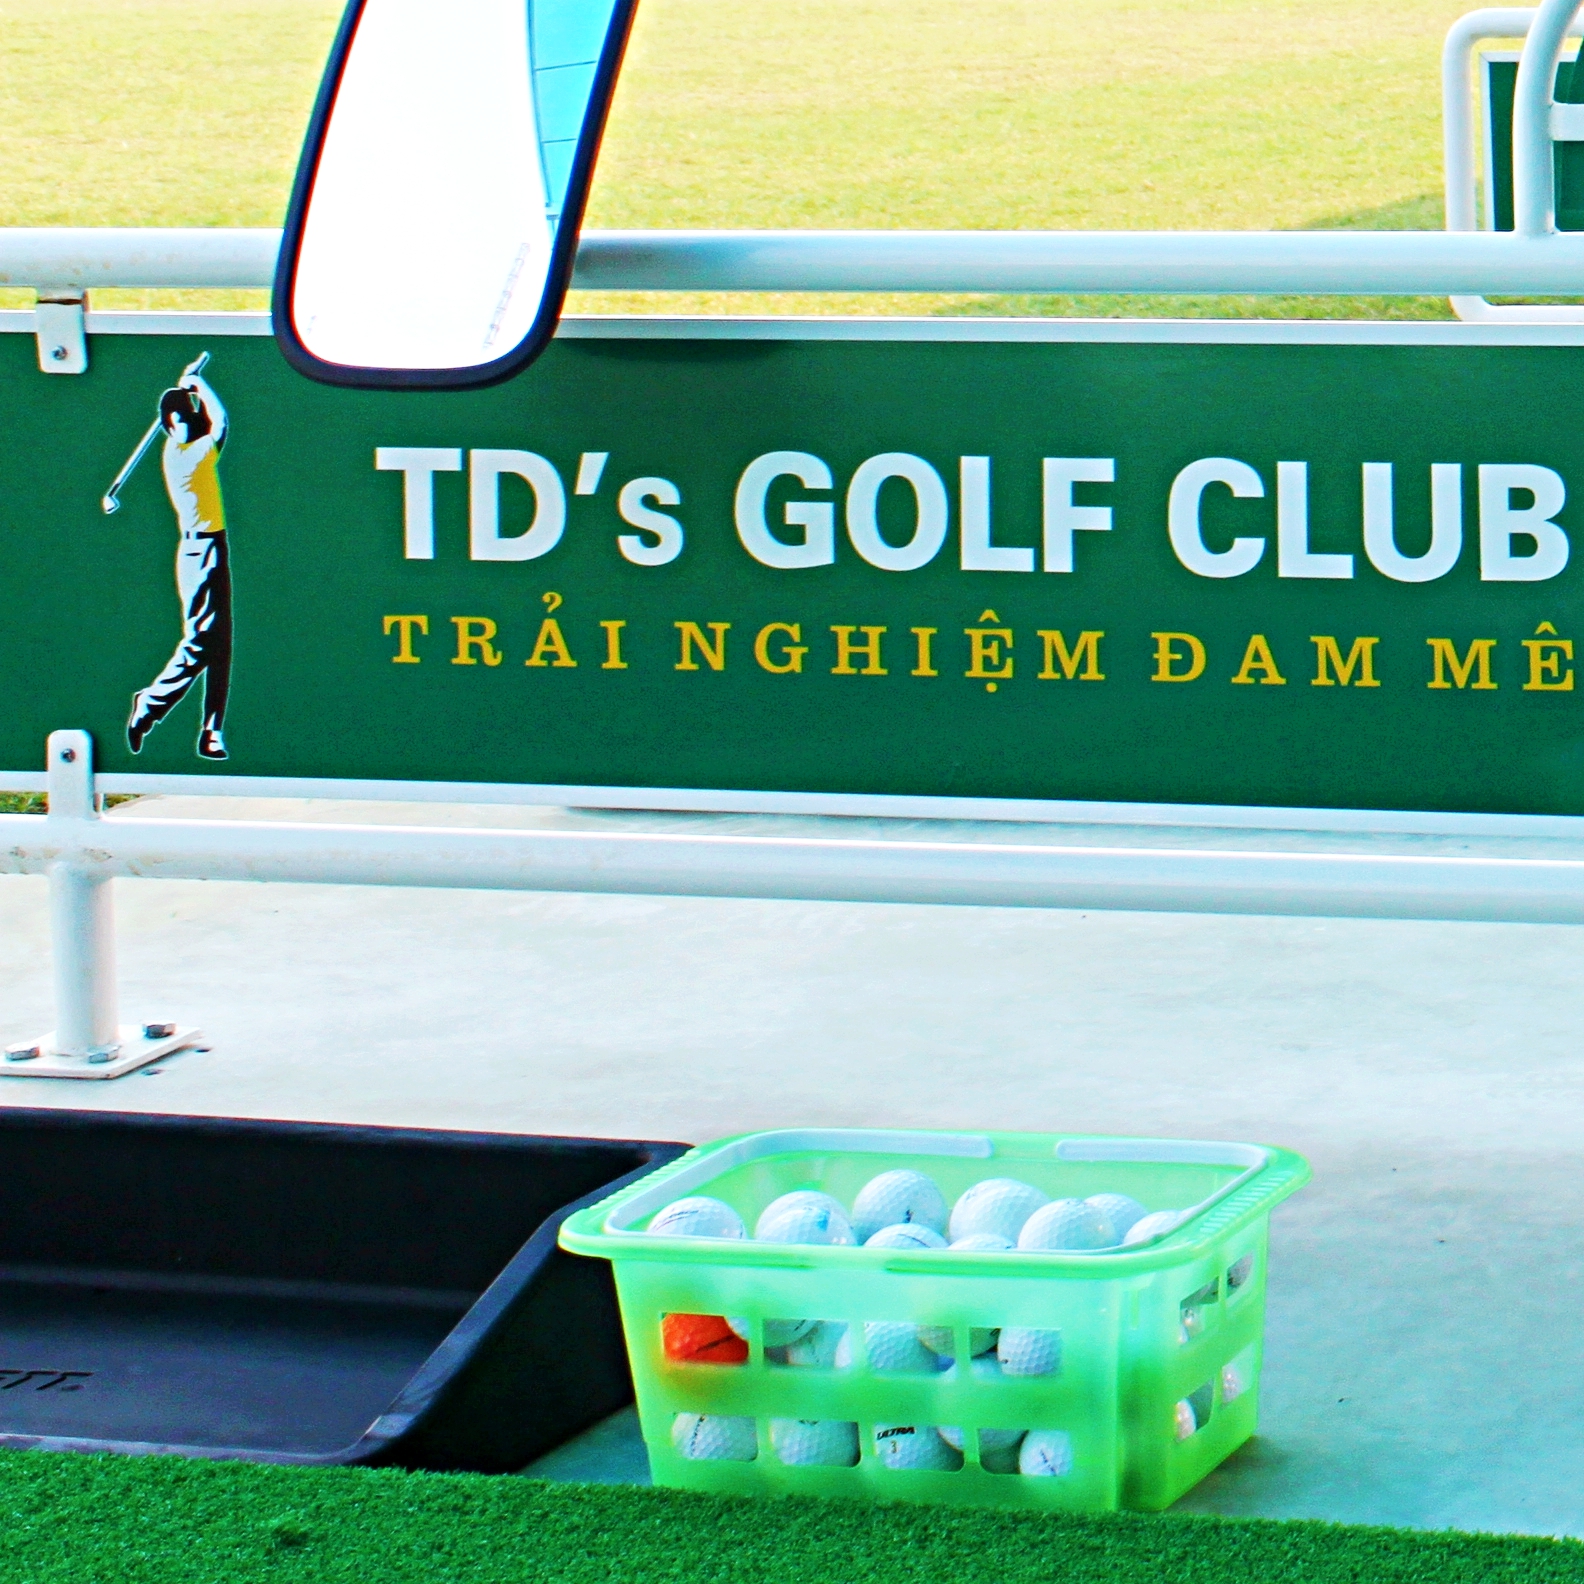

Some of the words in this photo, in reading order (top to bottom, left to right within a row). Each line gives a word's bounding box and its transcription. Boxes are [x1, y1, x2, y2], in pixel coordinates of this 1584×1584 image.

[374, 446, 684, 567] TD's
[734, 450, 1115, 573] GOLF
[1167, 457, 1570, 583] CLUB
[382, 591, 629, 670] TRẢI
[673, 609, 1105, 693] NGHIỆM
[1150, 630, 1382, 688] ĐAM
[1426, 620, 1575, 691] MÊ
[876, 1425, 916, 1441] ULTRA
